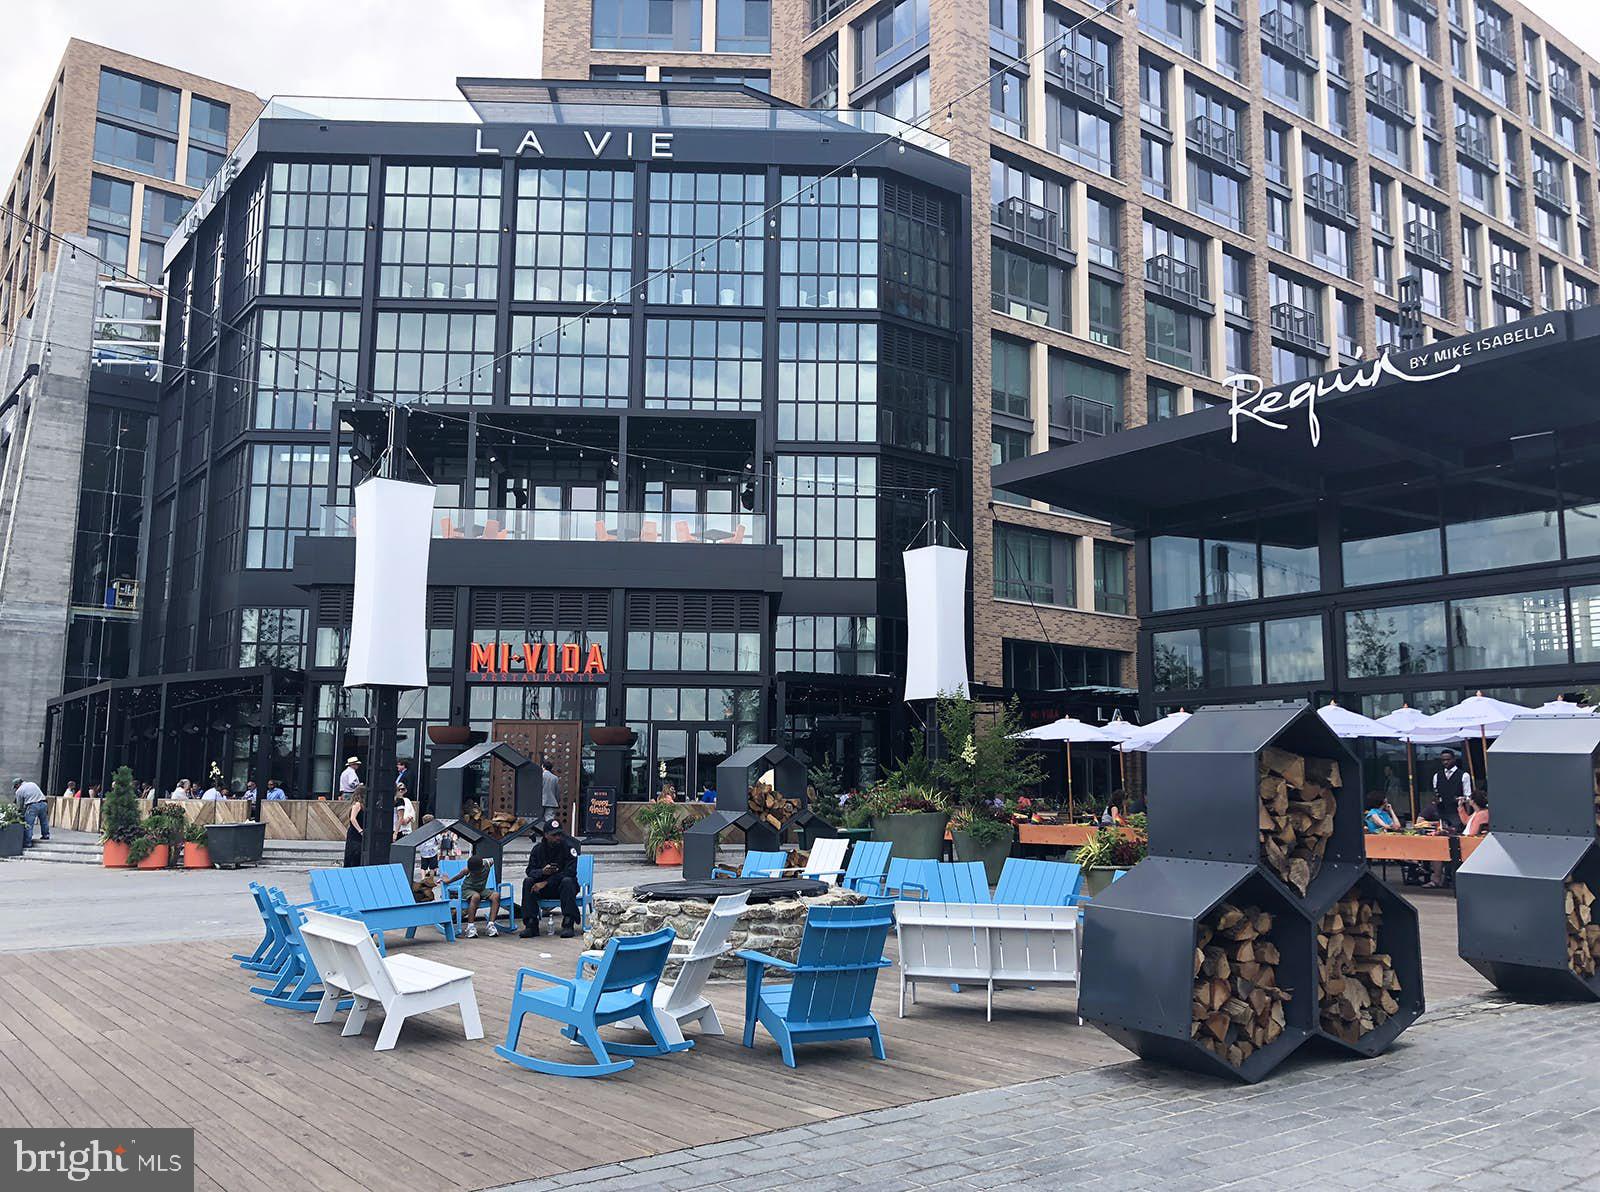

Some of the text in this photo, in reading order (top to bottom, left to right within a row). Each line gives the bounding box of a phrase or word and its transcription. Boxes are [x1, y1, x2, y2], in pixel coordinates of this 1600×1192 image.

[475, 128, 675, 159] LA VIE
[1409, 322, 1556, 370] BY MIKE ISABELLA
[1222, 346, 1461, 448] Requin
[480, 672, 596, 683] RESTAURANTE
